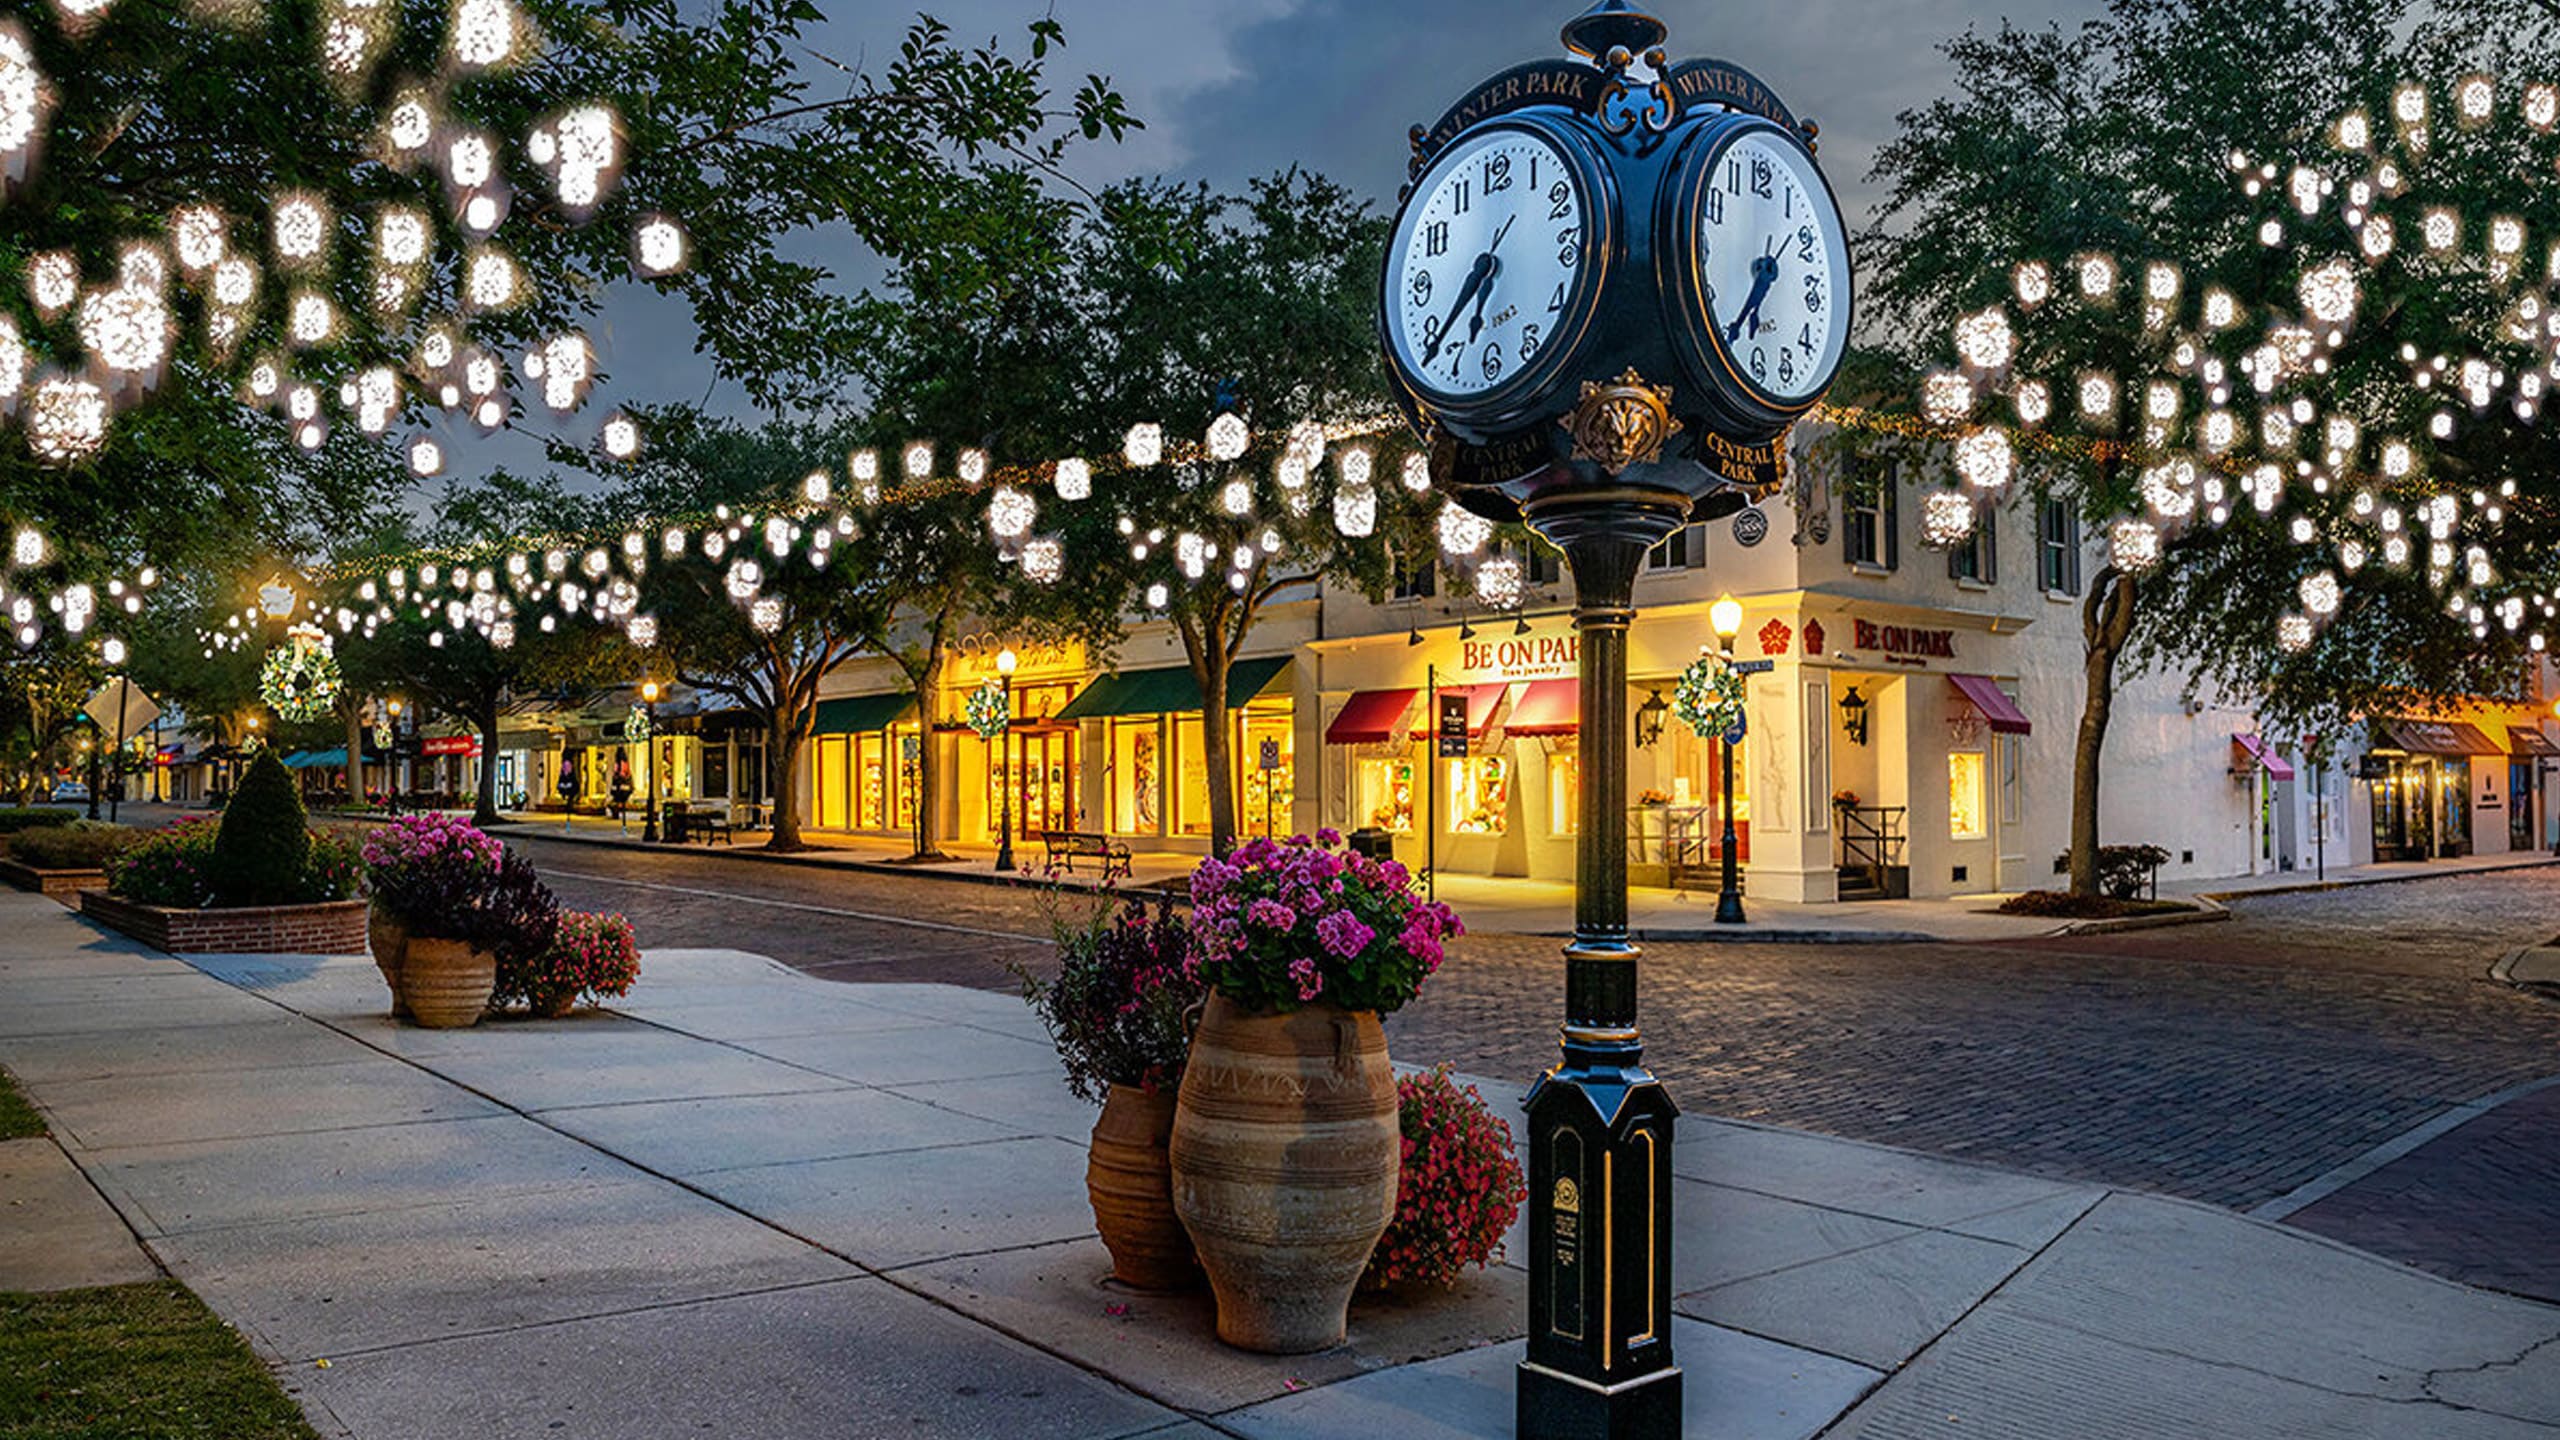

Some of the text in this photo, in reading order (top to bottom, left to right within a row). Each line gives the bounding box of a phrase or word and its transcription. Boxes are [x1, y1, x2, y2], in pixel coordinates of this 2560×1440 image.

[1678, 69, 1749, 101] WINTER
[1435, 71, 1589, 145] WINTER PARK
[1483, 154, 1513, 196] 12
[1529, 156, 1538, 191] 1
[1728, 159, 1741, 196] 11
[1751, 159, 1773, 200] 12
[1453, 179, 1470, 216] 11
[1548, 180, 1573, 222] 2
[1784, 186, 1791, 219] 1
[1425, 220, 1450, 258] 10
[1556, 225, 1581, 269] 3
[1798, 225, 1815, 263] 2
[1413, 270, 1433, 308] 9
[1547, 281, 1566, 314] 4
[1804, 275, 1820, 313] 3
[1423, 315, 1441, 352] 8
[1519, 323, 1541, 362] 5
[1797, 322, 1816, 357] 4
[1444, 340, 1467, 377] 7
[1482, 342, 1502, 382] 6
[1750, 346, 1767, 384] 6
[1778, 346, 1793, 383] 5
[1706, 432, 1771, 465] CENTRAL
[1721, 460, 1757, 483] PARK
[1463, 636, 1583, 670] BE ON PAR
[1854, 618, 1955, 659] BE ON PARK
